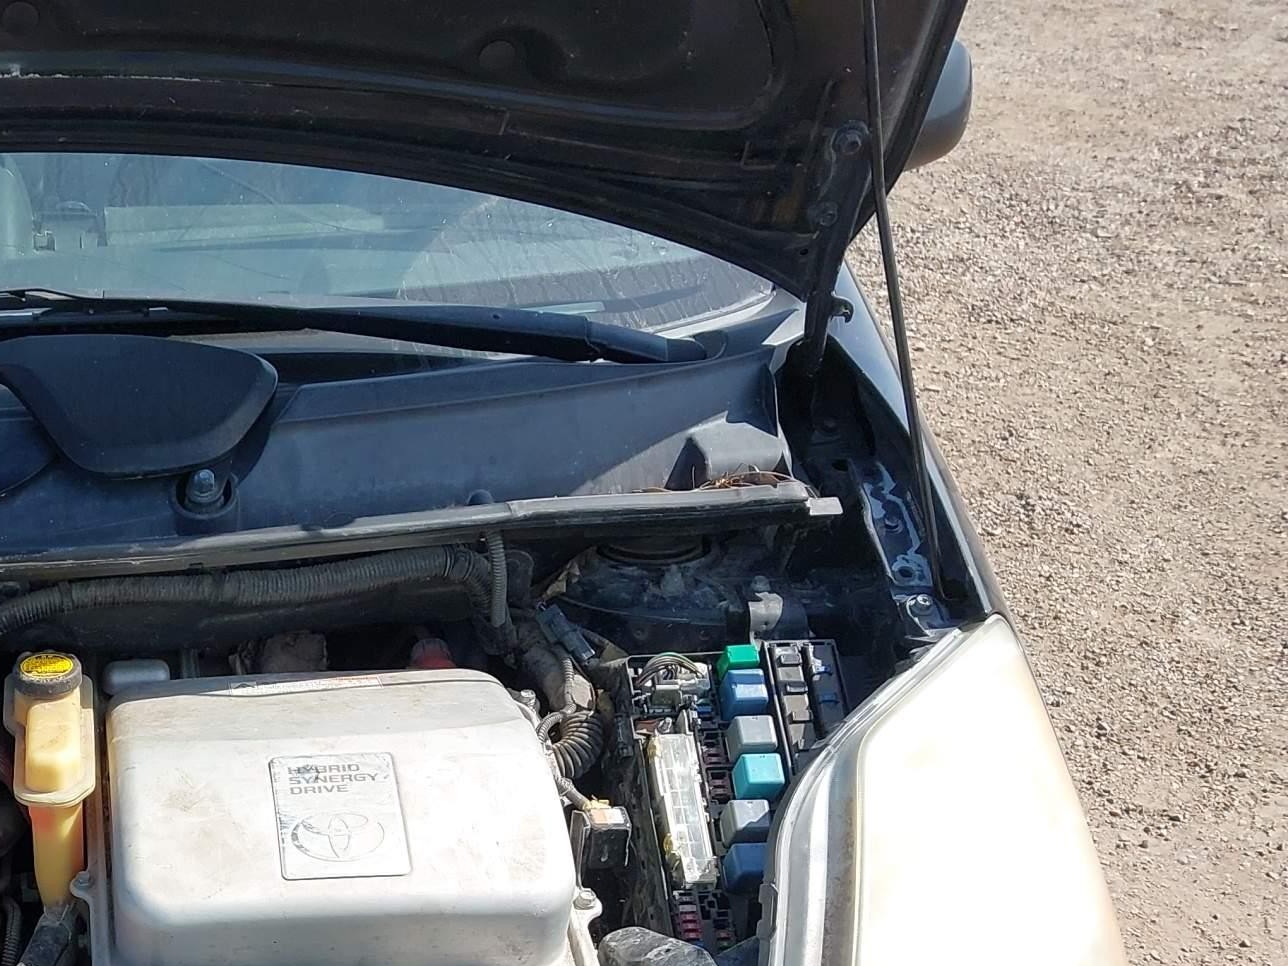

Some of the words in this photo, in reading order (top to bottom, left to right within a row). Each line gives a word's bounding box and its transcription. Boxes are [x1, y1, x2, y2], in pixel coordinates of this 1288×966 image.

[287, 764, 360, 775] HYBRID
[288, 773, 378, 785] SYNERGY
[289, 784, 350, 795] DRIVE
